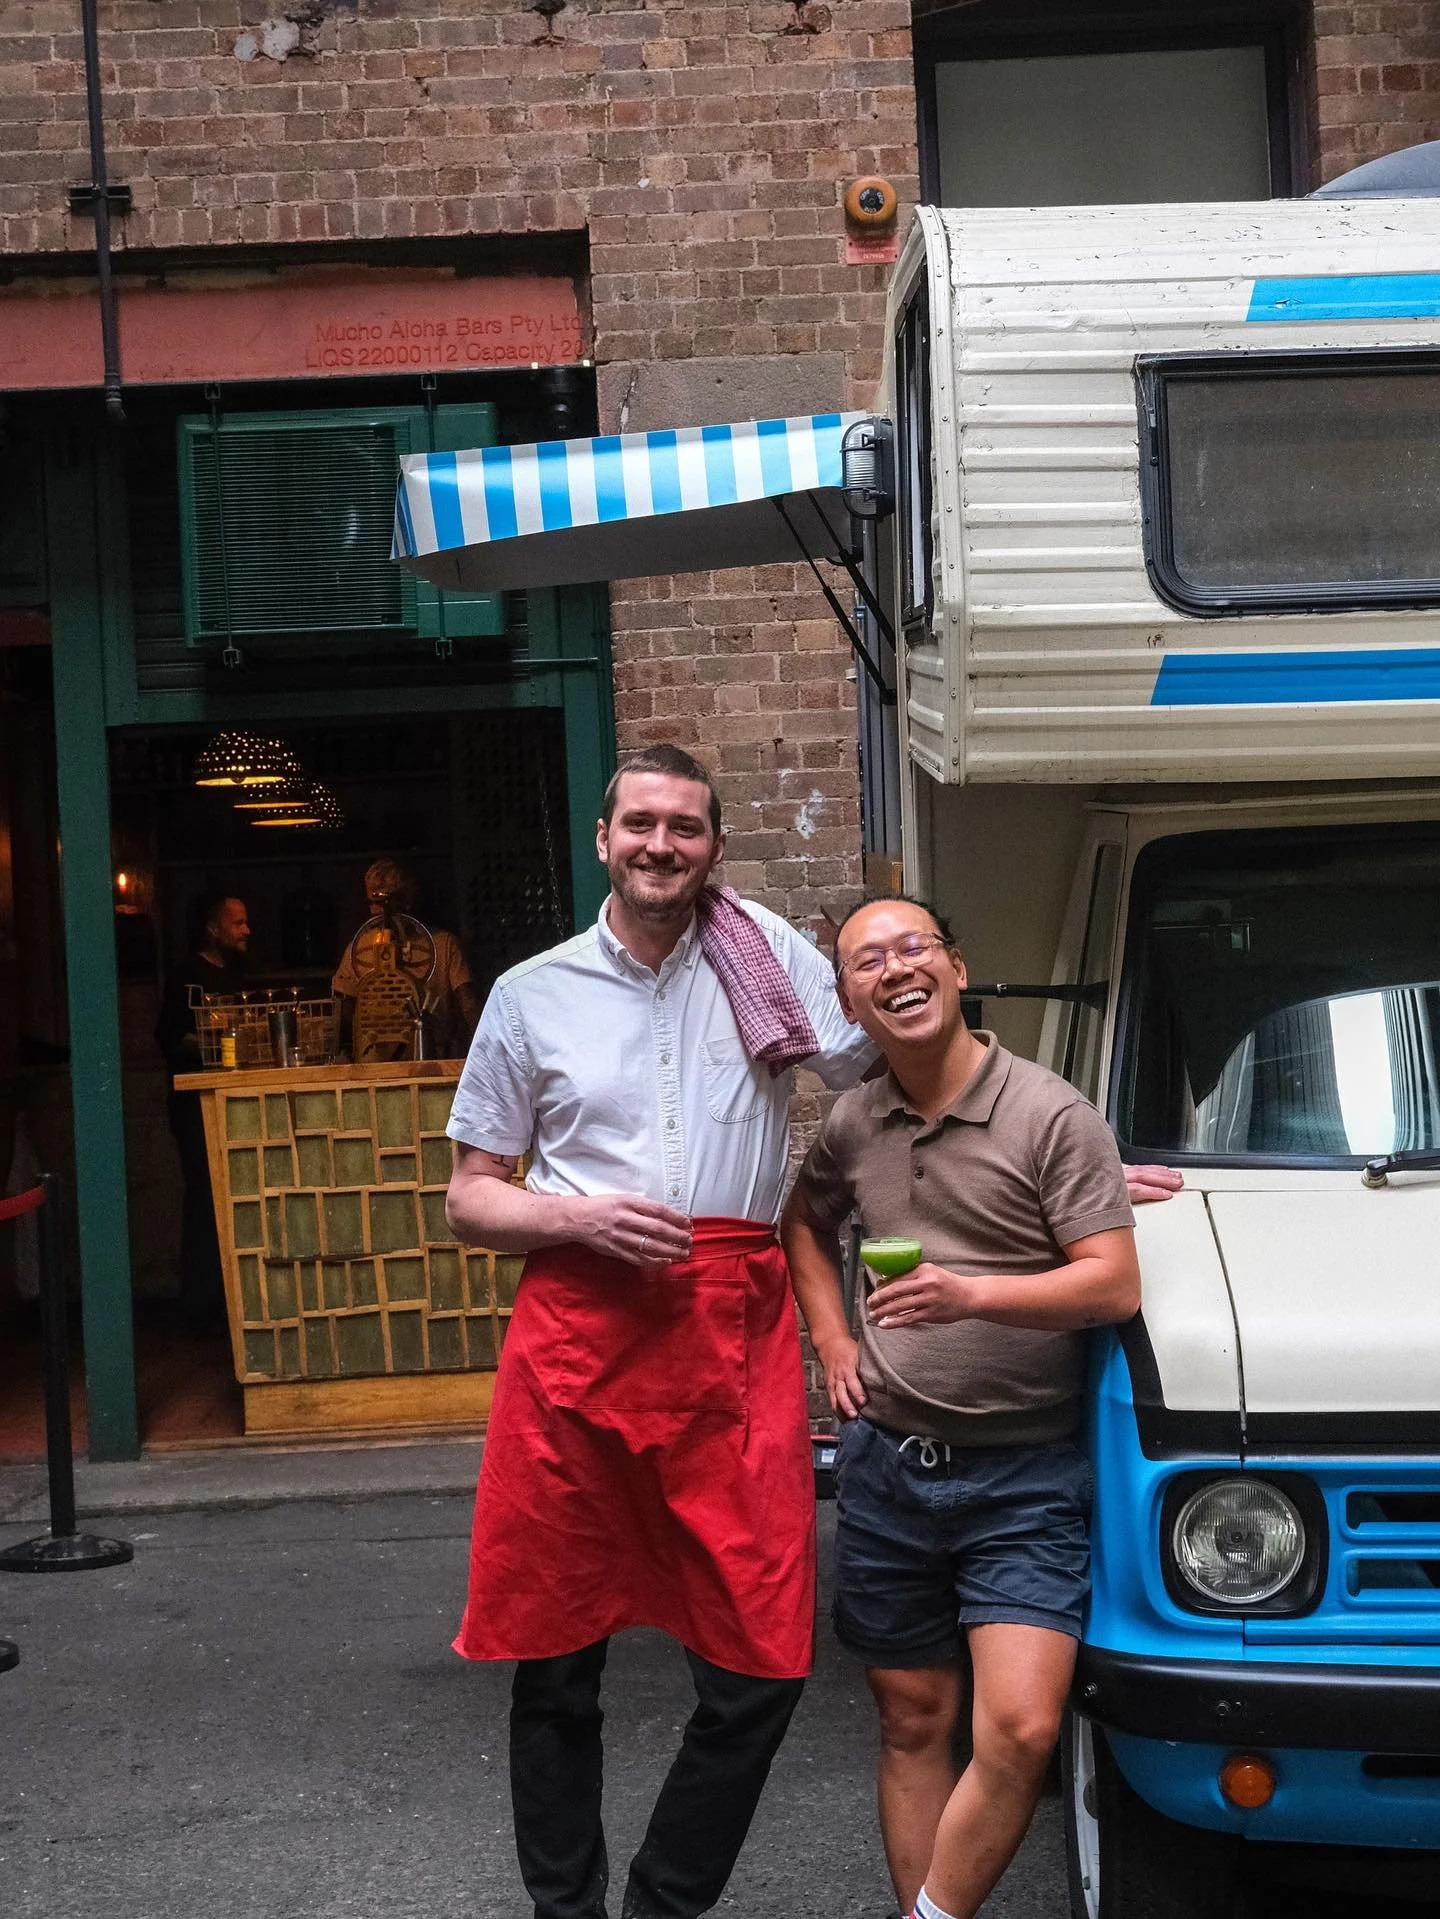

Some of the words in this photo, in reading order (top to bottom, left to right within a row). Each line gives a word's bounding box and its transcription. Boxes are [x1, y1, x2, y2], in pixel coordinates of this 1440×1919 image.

[315, 322, 383, 342] Mucho
[389, 319, 449, 340] Aloha
[456, 316, 503, 336] Bars
[510, 314, 544, 337] Pty
[465, 341, 555, 364] Capacity
